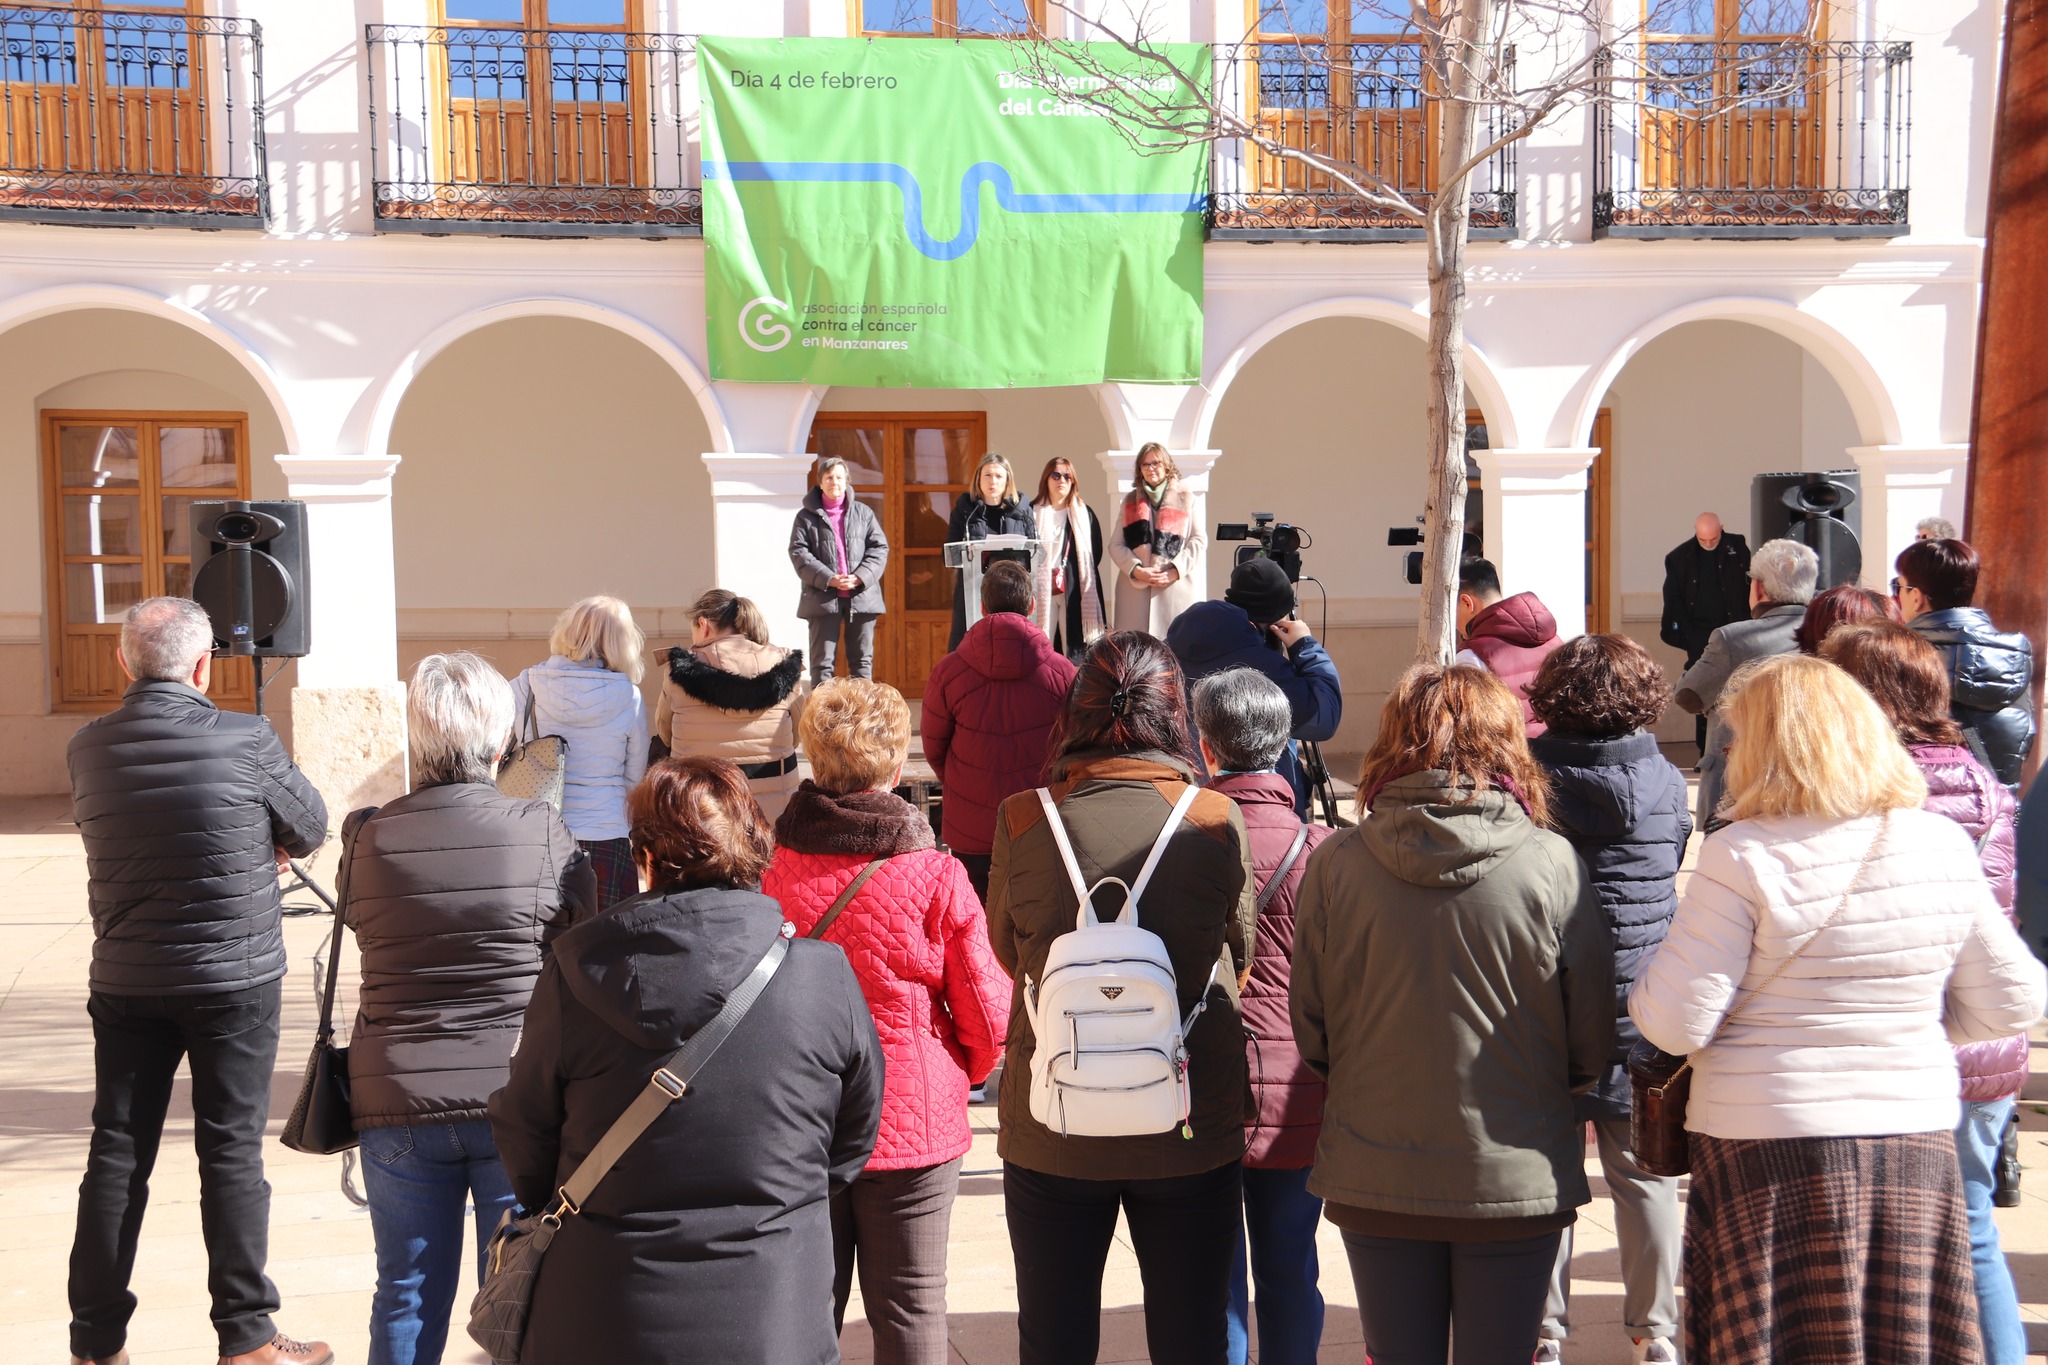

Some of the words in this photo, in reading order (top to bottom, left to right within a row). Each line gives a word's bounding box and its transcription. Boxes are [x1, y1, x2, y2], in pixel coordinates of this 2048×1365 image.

[731, 70, 763, 88] Día
[770, 73, 782, 90] 4
[788, 71, 815, 88] de
[821, 71, 898, 89] febrero
[999, 98, 1034, 116] del
[802, 302, 877, 314] asociación
[882, 302, 947, 316] española
[802, 320, 848, 332] contra
[851, 320, 864, 332] el
[867, 320, 917, 332] cáncer
[802, 335, 819, 347] en
[822, 336, 909, 351] Manzanares
